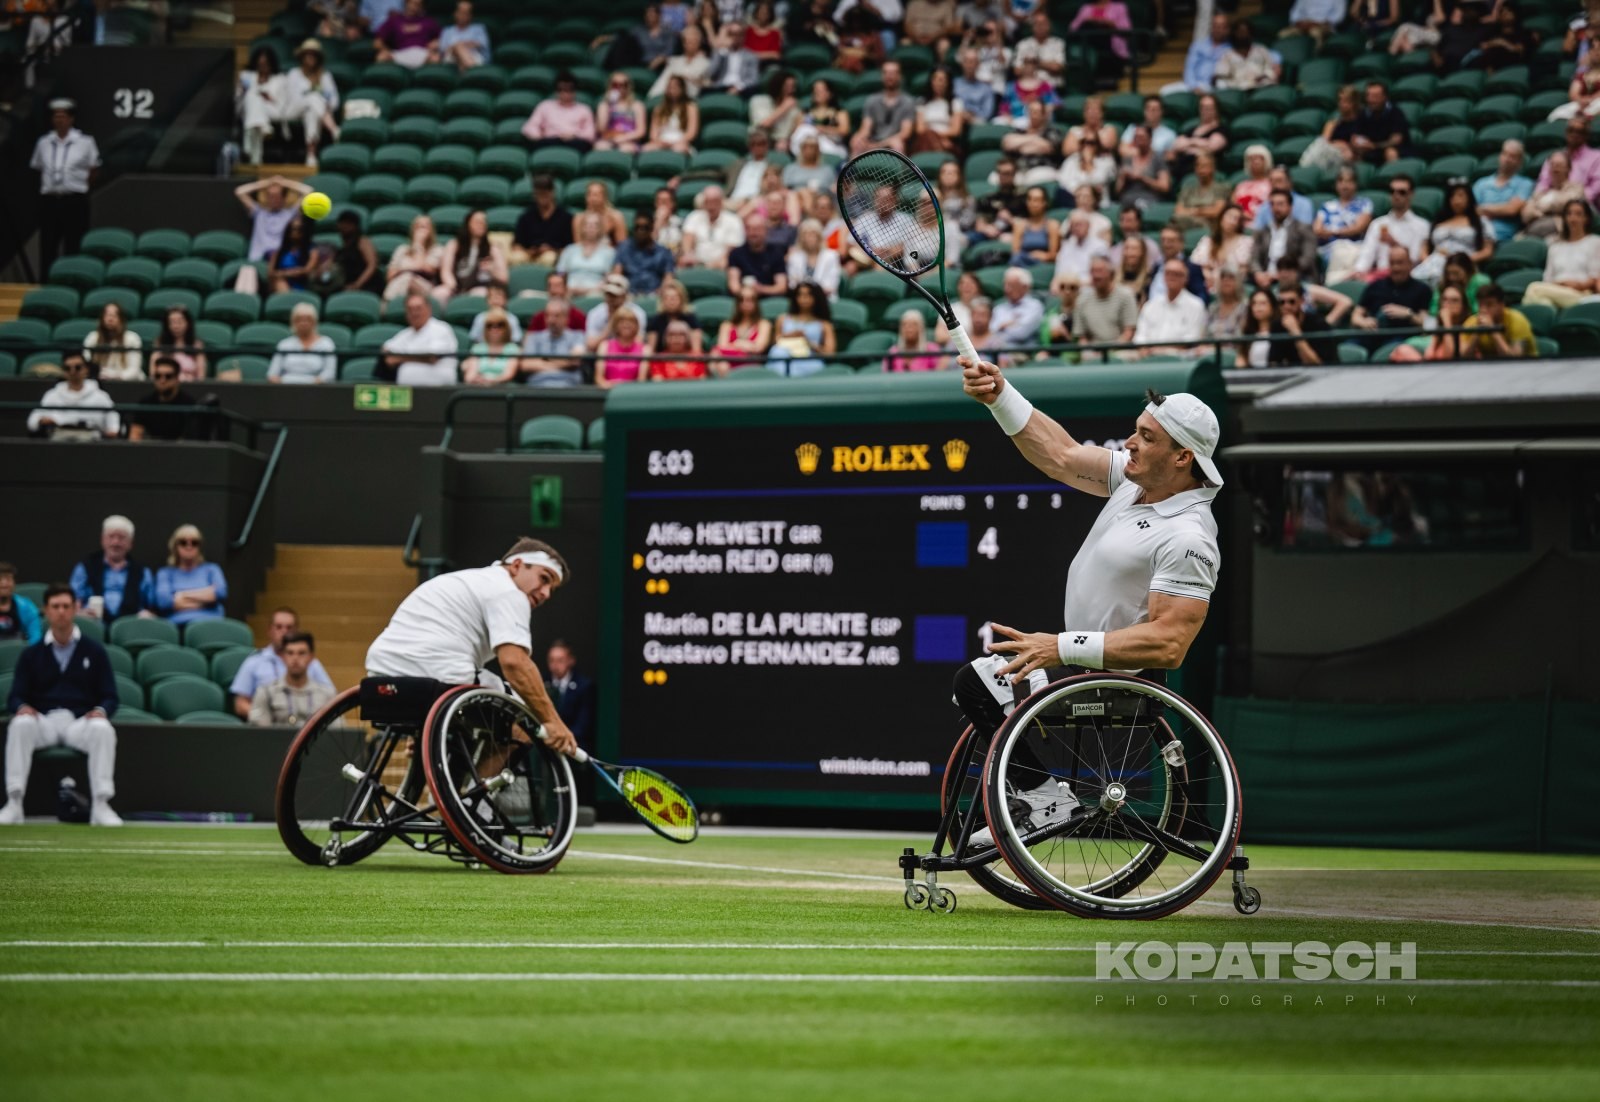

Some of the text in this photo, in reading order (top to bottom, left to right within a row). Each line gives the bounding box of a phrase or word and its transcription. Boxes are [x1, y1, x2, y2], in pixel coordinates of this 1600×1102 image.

[113, 88, 154, 118] 32
[648, 450, 694, 476] 5:03
[832, 445, 931, 472] ROLEX
[920, 493, 1062, 511] POINTS 1 2 3
[646, 521, 822, 545] Alfie HEWETT GBR
[977, 526, 999, 560] 4
[646, 549, 722, 573] Gordon
[725, 549, 779, 573] REID
[781, 552, 813, 573] GBR
[1188, 550, 1214, 569] BANCOR
[711, 612, 744, 636] DE
[746, 612, 777, 636] LA
[778, 612, 868, 636] PUENTE
[870, 617, 902, 636] ESP
[643, 640, 900, 665] Gustavo FERNANDEZ ARG
[1076, 704, 1103, 712] BANCOR
[820, 757, 930, 776] wimbledon.com
